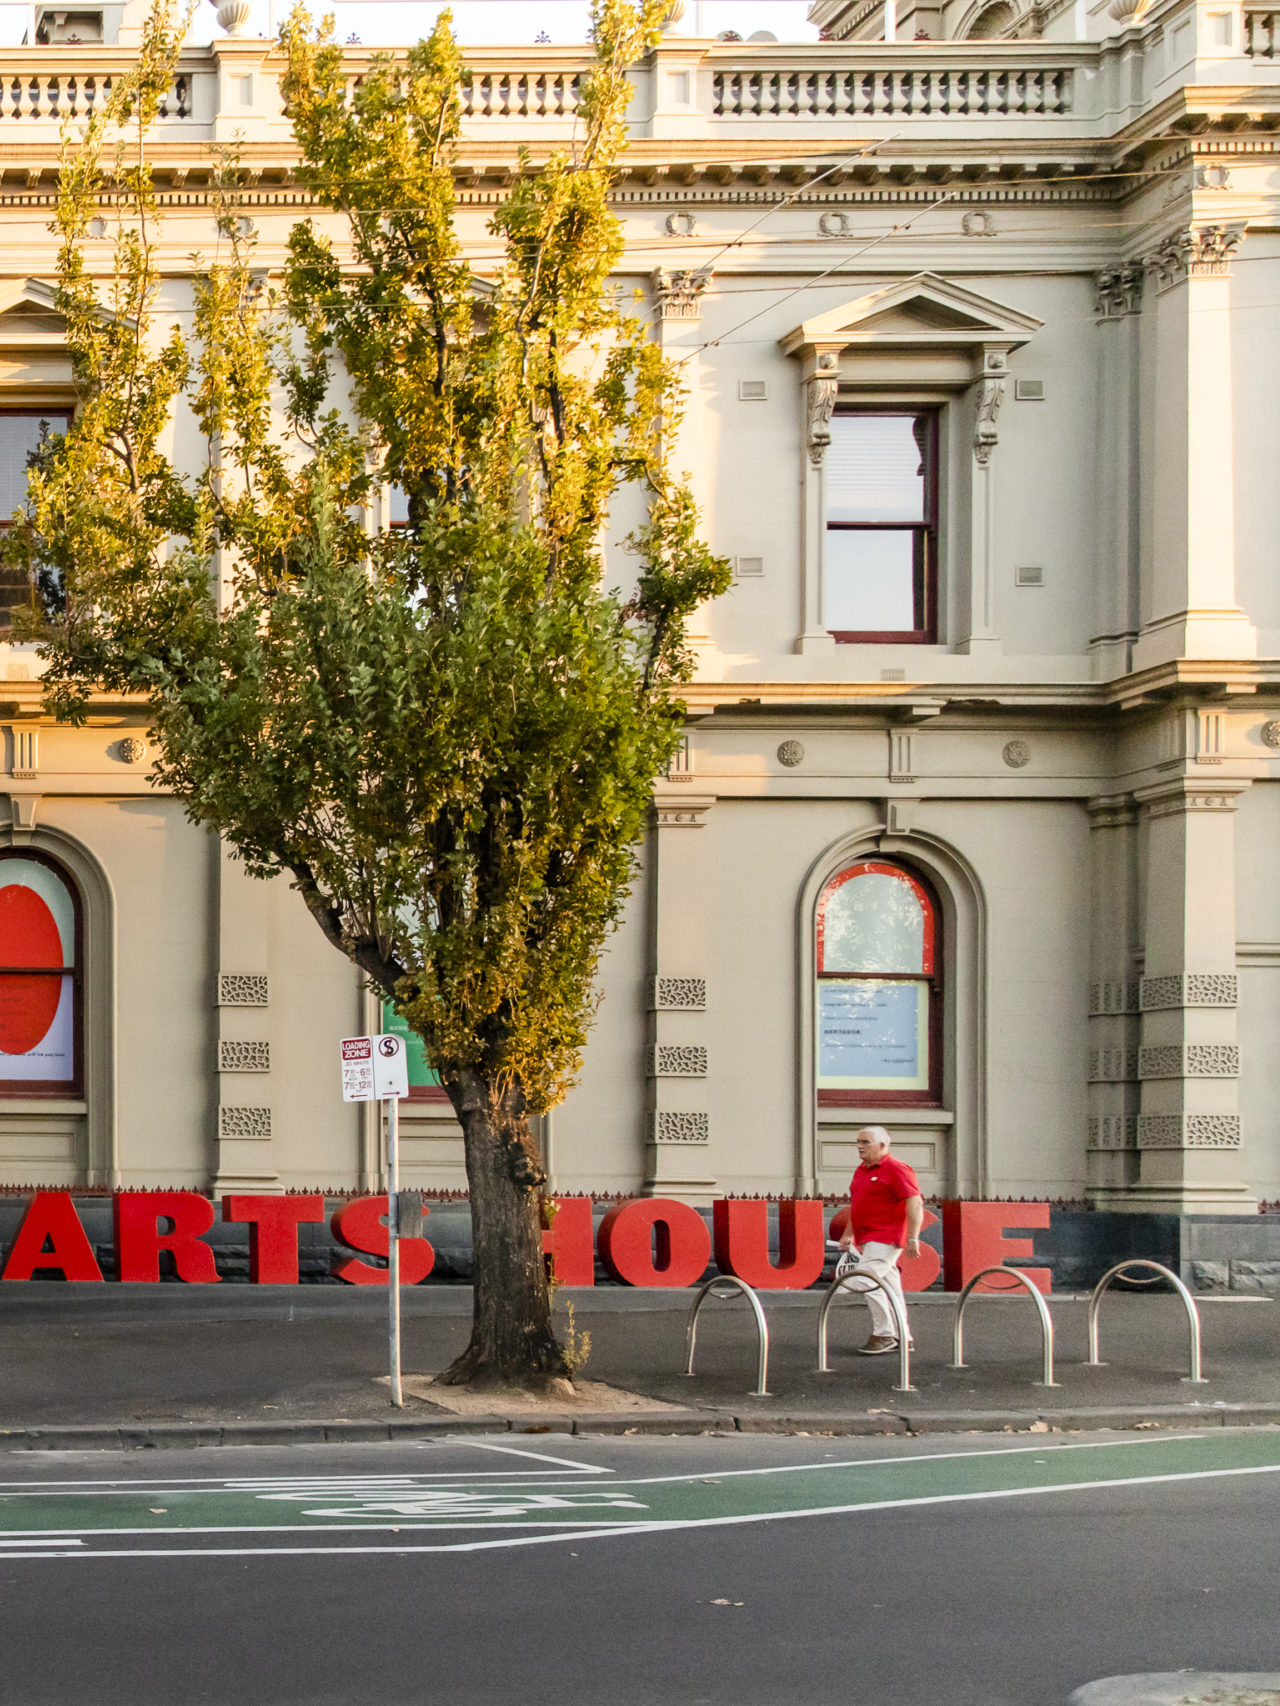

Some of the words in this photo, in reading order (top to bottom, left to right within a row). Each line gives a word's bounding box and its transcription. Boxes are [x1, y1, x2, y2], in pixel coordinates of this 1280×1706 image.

[342, 1041, 370, 1051] LOADING
[344, 1049, 369, 1058] ZONE
[0, 1191, 436, 1286] ARTS
